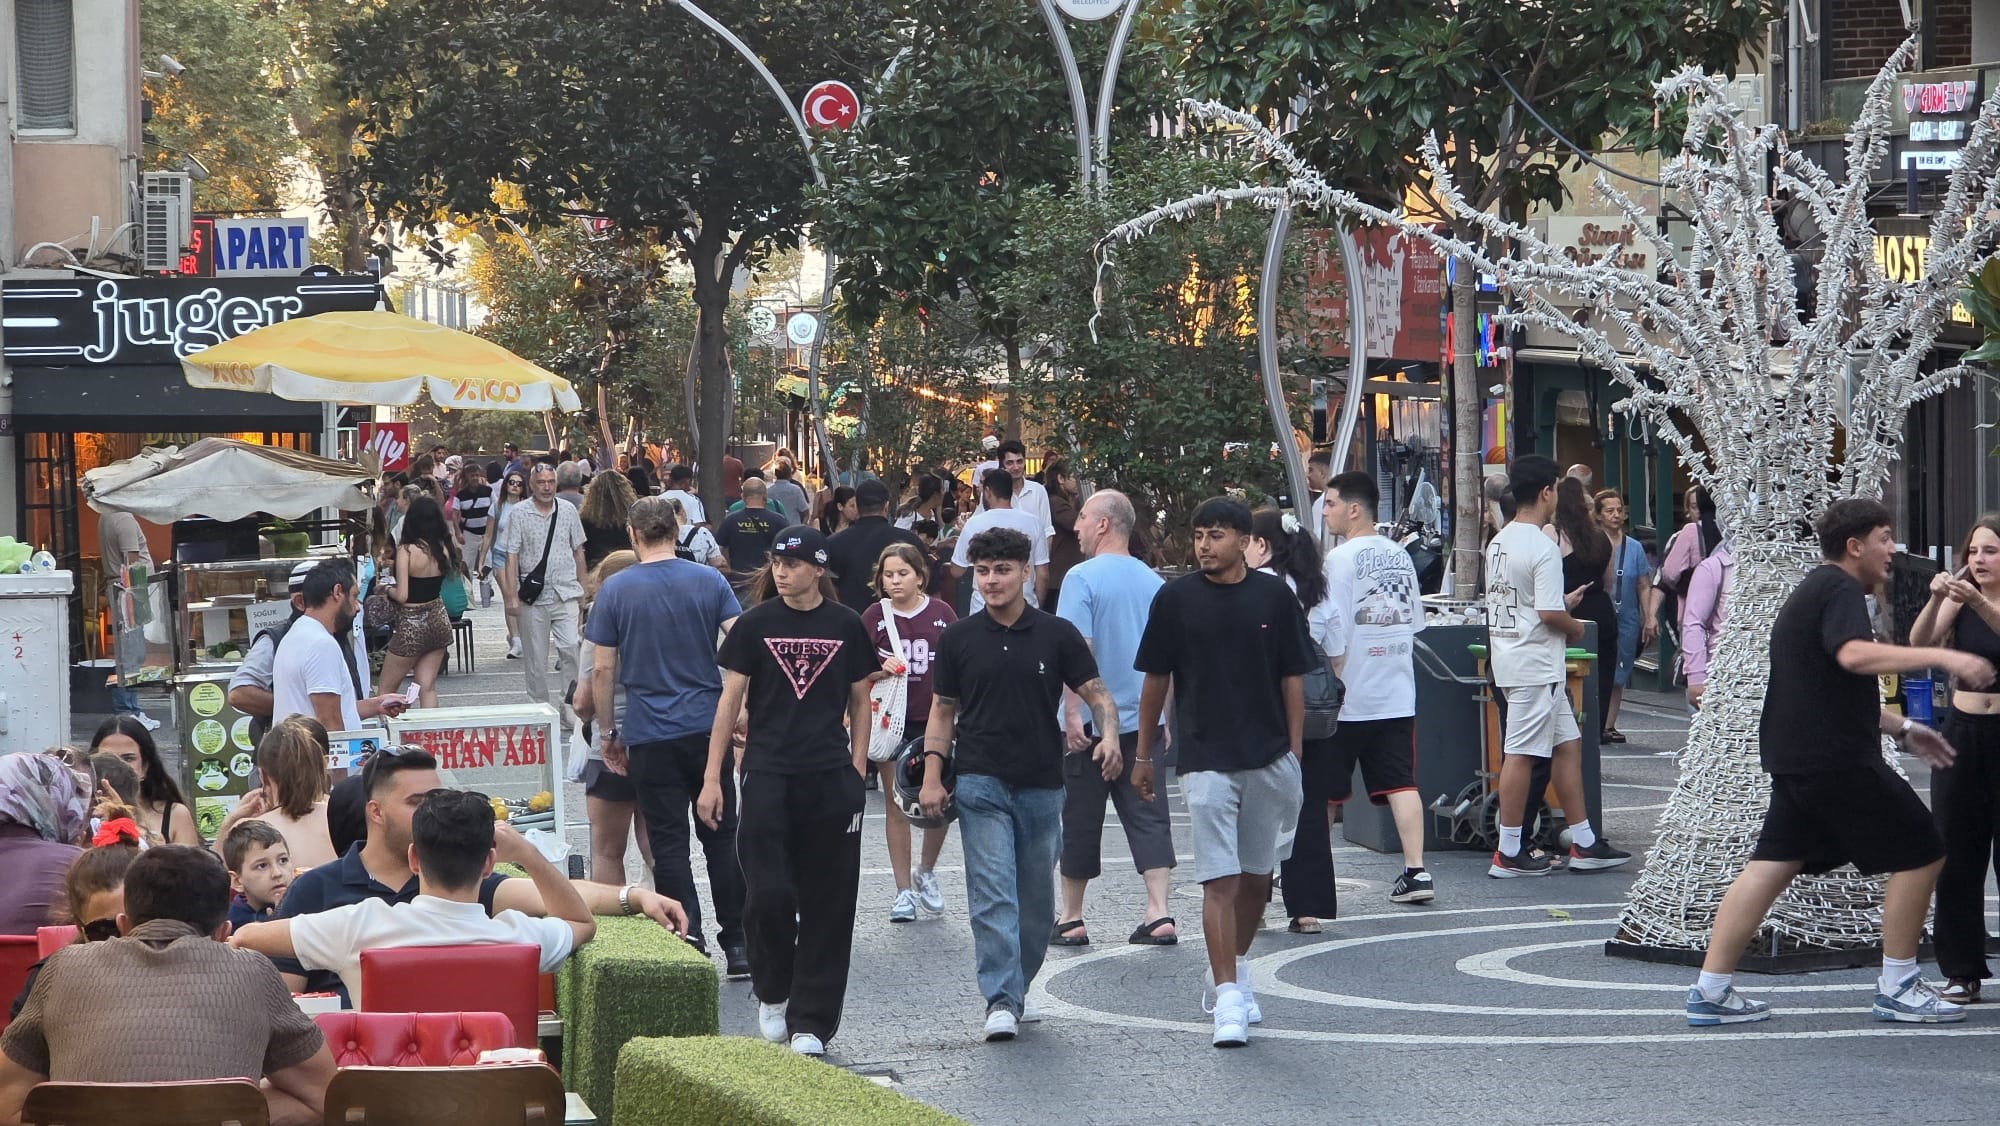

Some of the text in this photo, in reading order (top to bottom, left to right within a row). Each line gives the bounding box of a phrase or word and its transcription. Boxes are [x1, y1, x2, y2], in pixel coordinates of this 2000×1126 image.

[1578, 223, 1636, 246] Simit
[84, 280, 303, 362] juger
[777, 642, 830, 656] GUESS
[424, 739, 496, 769] YHAN
